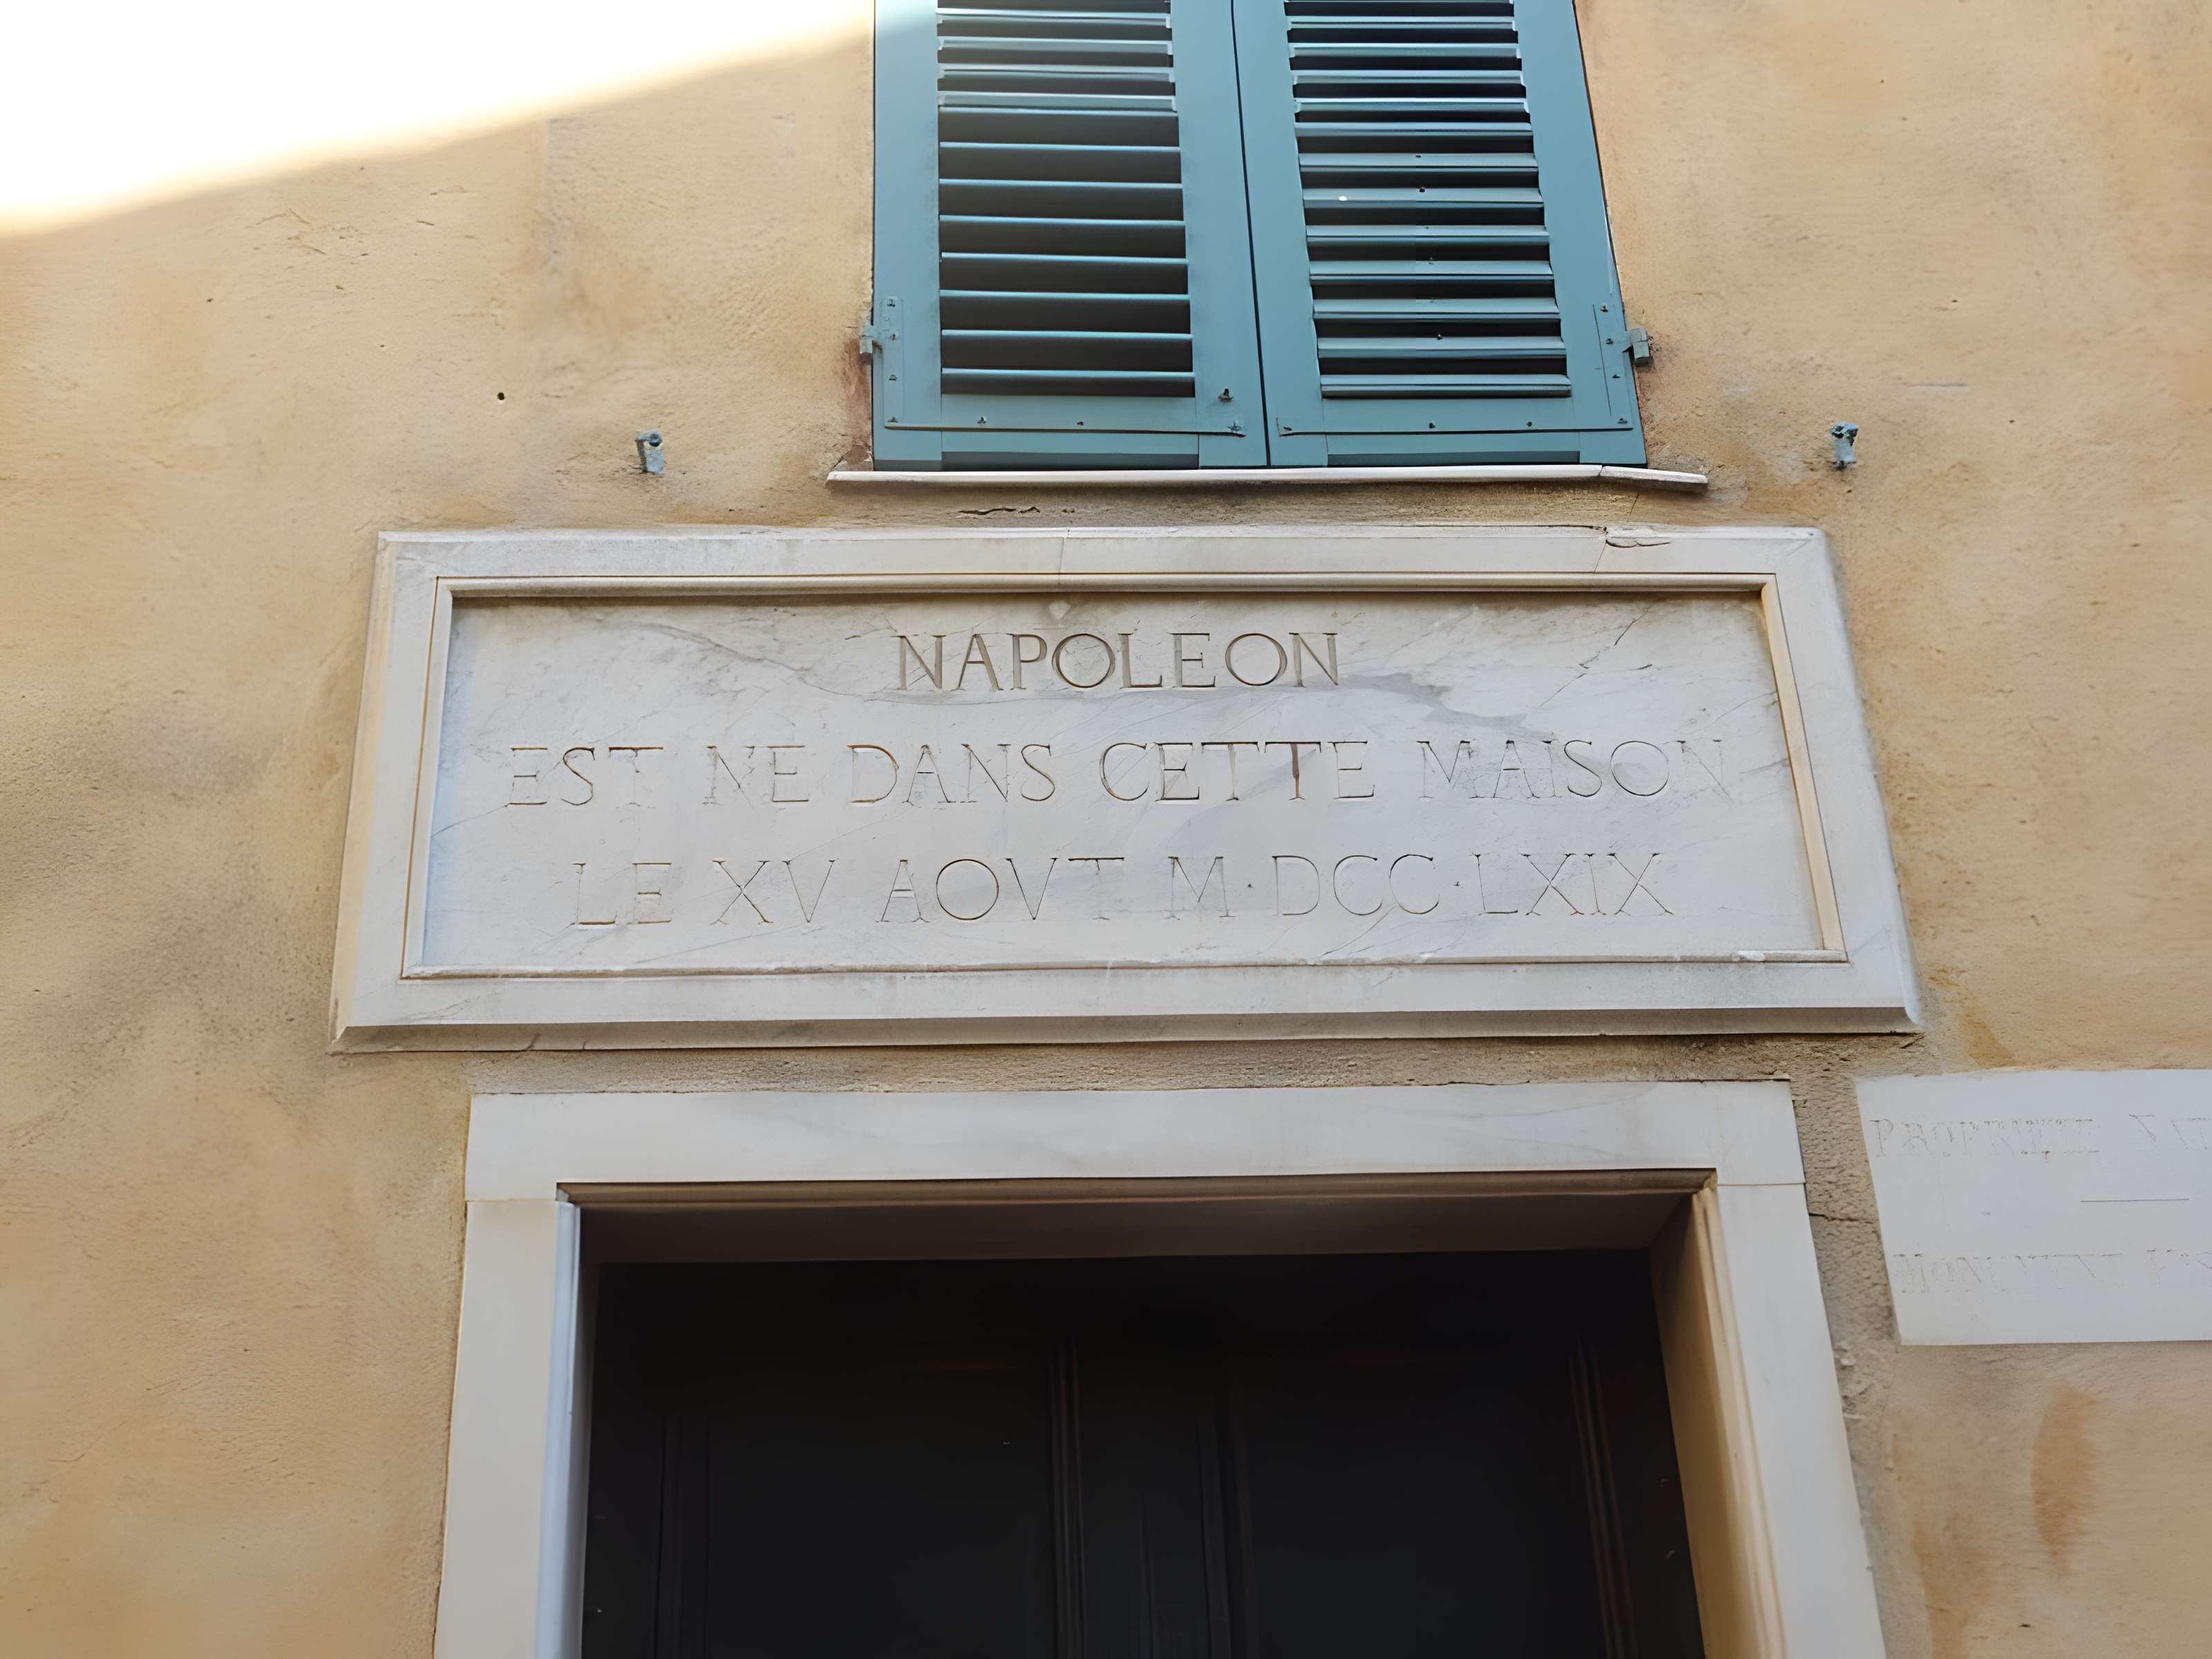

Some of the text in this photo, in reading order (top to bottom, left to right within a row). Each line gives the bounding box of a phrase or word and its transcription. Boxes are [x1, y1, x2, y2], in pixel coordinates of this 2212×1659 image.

[896, 632, 1339, 691] NAPOLEON
[506, 739, 1732, 807] EST NE DANS CETTE MAISON
[567, 862, 673, 926] LE
[711, 859, 836, 925] XV
[875, 857, 1125, 923] AOVT
